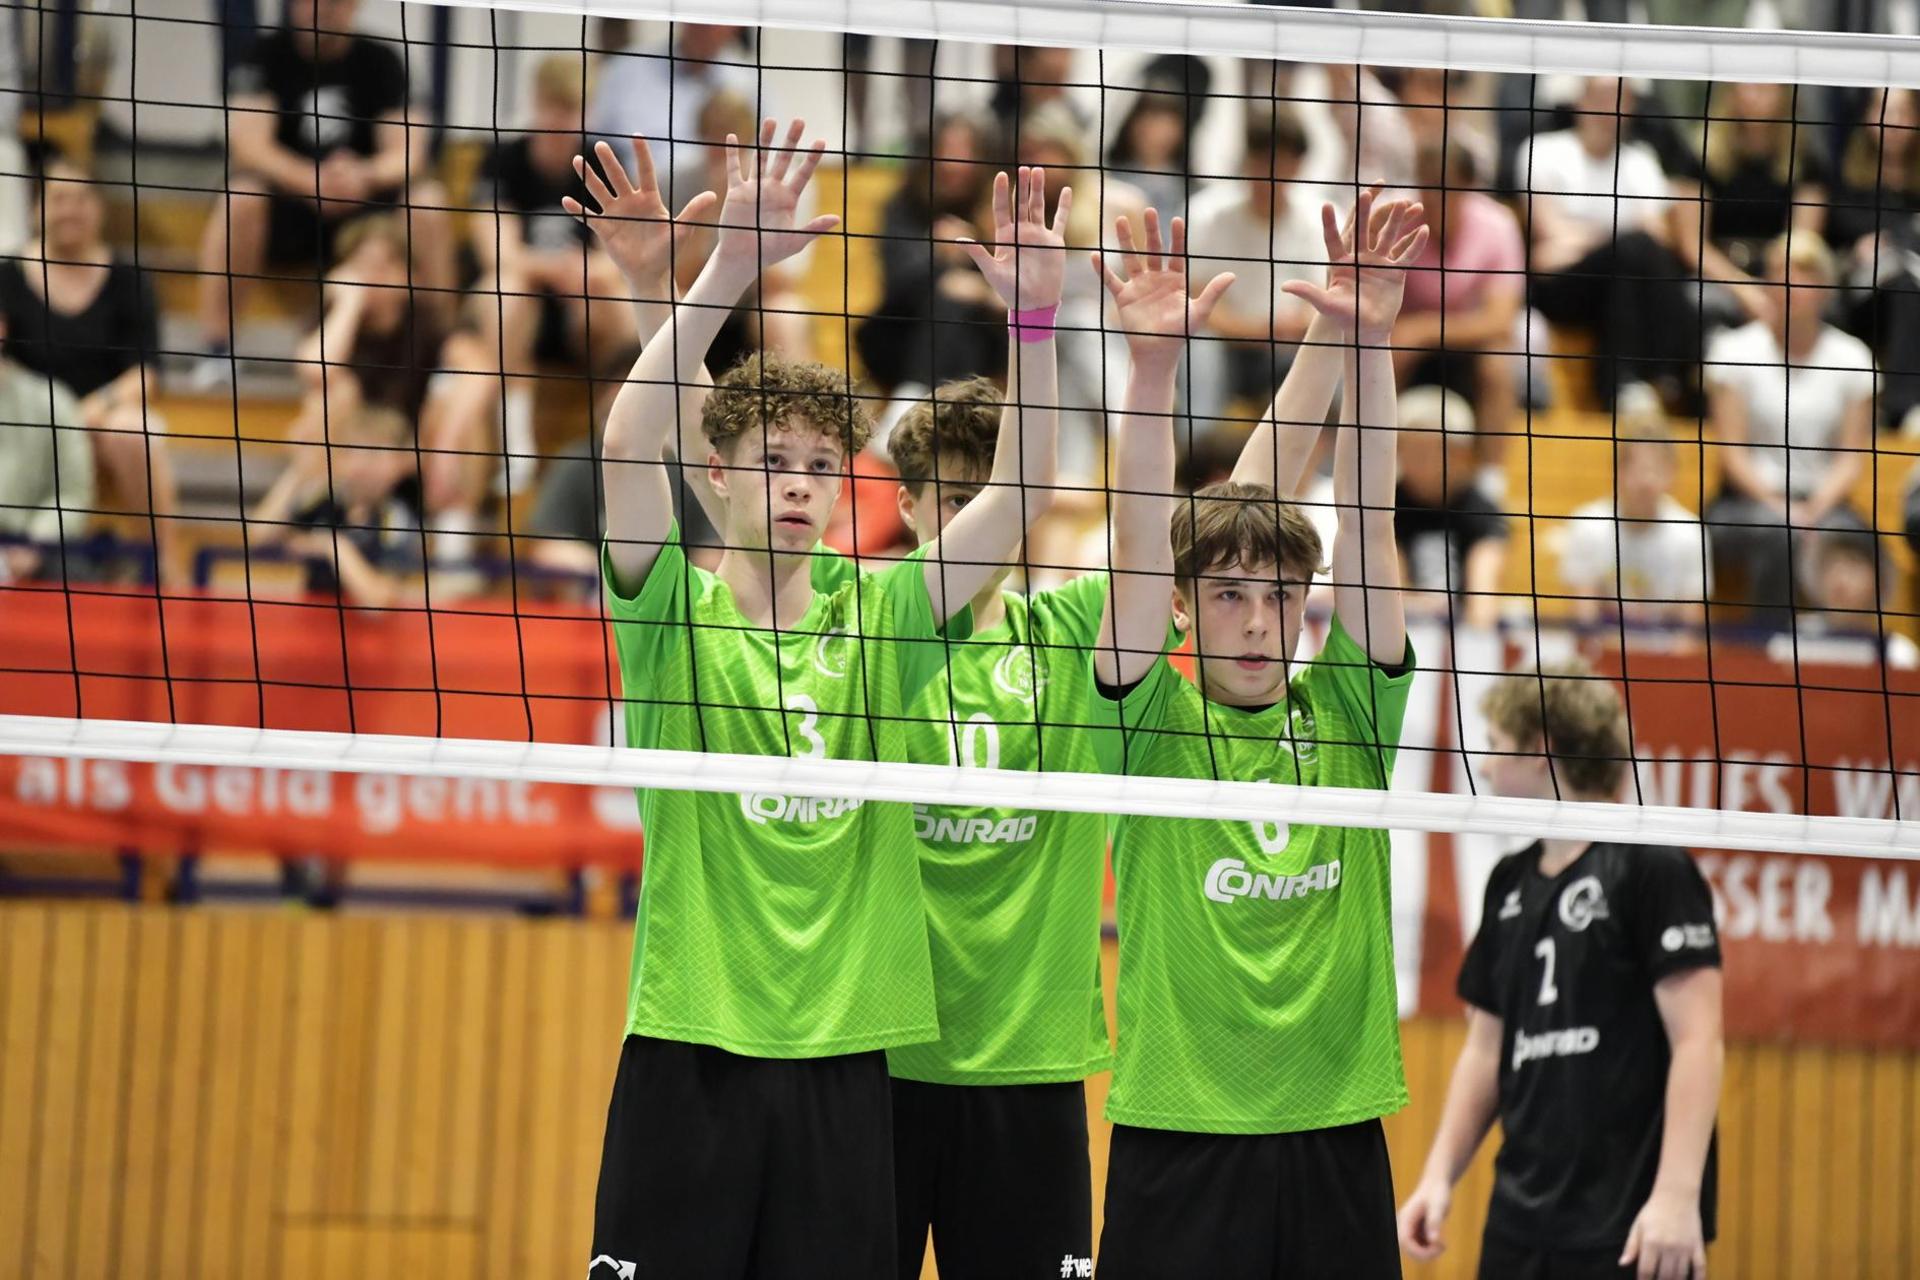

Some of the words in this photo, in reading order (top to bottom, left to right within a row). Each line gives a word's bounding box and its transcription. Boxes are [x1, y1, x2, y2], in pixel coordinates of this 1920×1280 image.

[785, 693, 826, 758] 3
[948, 710, 999, 769] 10
[16, 755, 131, 810] als
[1204, 858, 1341, 904] CONRAD
